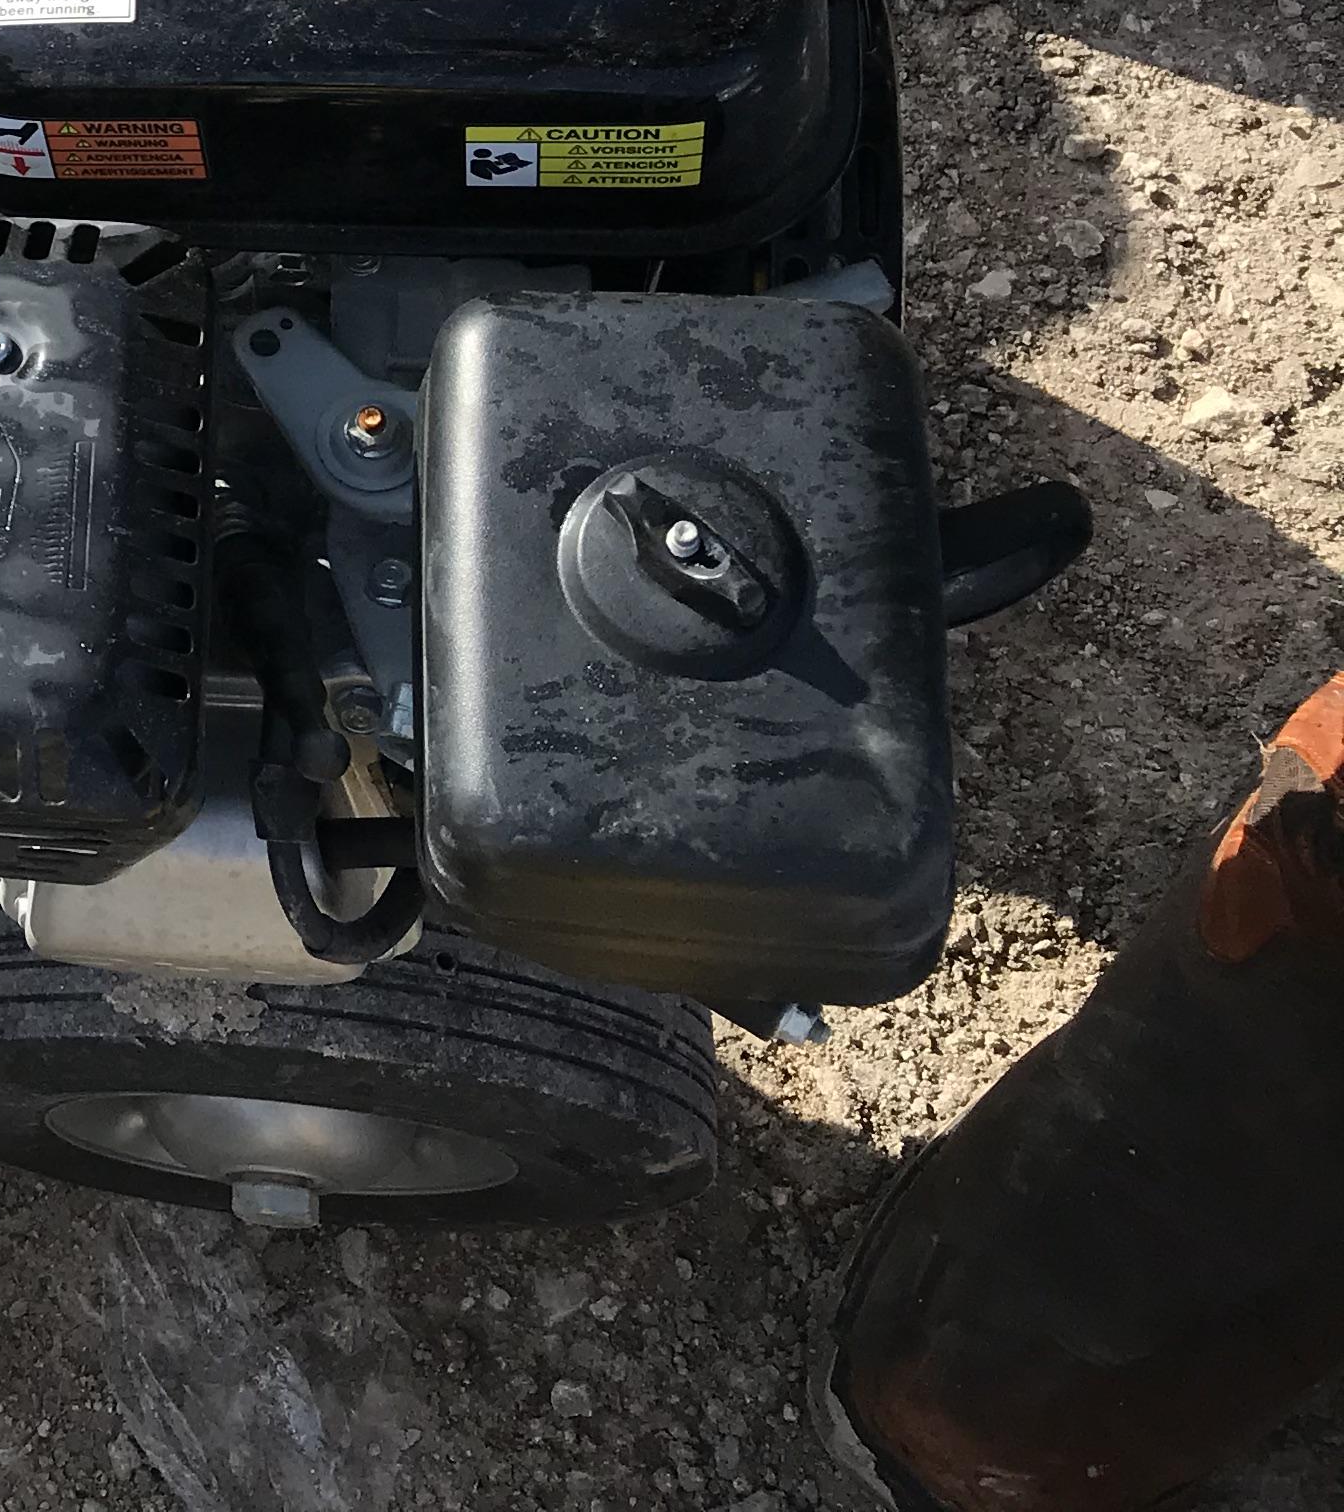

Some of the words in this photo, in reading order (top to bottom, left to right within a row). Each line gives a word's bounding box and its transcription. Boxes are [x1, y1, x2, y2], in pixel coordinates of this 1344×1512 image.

[0, 6, 34, 17] been
[82, 123, 185, 134] WARNING
[546, 128, 661, 140] CAUTION
[96, 140, 169, 148] WARNUNG
[590, 145, 677, 155] VORSICHT
[86, 154, 184, 162] ADVERTENCIA
[591, 160, 678, 170] ATENCIÓN
[81, 168, 195, 176] AVERTISSEMENT
[587, 175, 682, 184] ATTENTION
